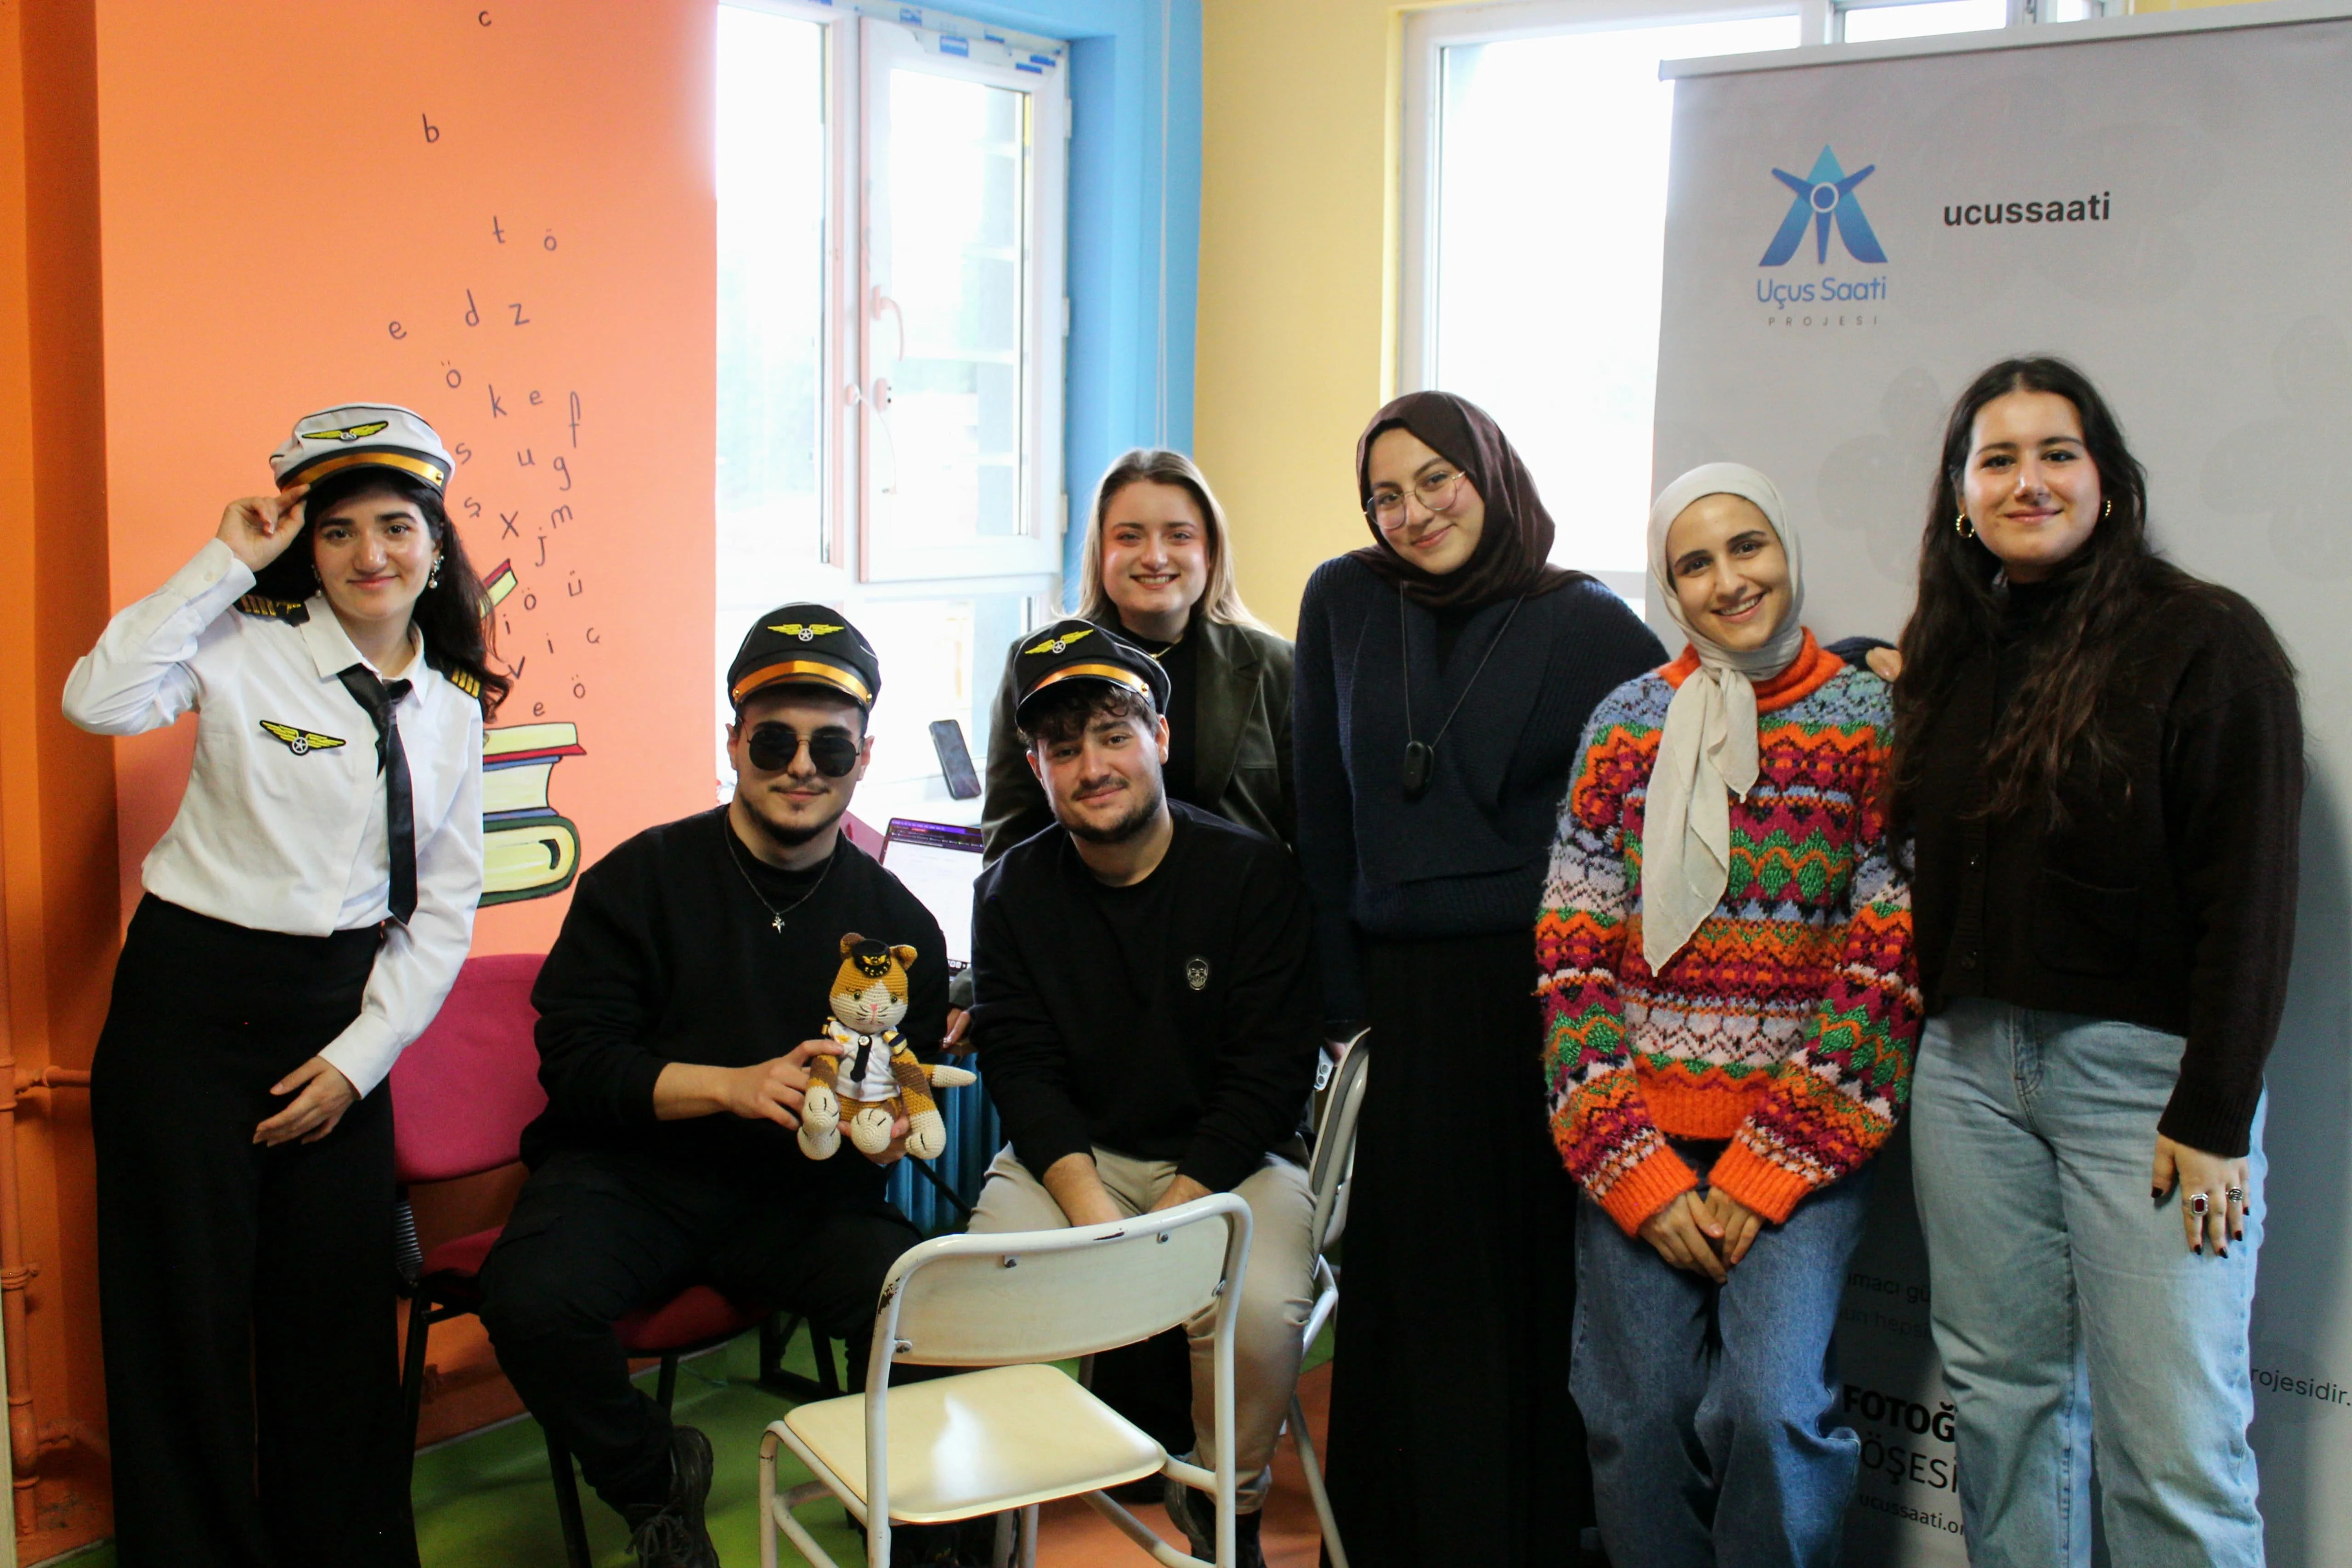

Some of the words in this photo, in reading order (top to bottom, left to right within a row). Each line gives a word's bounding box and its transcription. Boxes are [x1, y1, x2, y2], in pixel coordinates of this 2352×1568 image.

[478, 11, 492, 27] c
[422, 113, 440, 143] b
[1944, 192, 2110, 226] ucussaati
[493, 215, 505, 243] t
[1757, 278, 1815, 310] Uçus
[1820, 276, 1887, 301] Saati
[465, 289, 480, 327] d
[389, 321, 407, 340] e
[441, 361, 462, 389] ö
[488, 384, 507, 418] k
[530, 391, 543, 405] e
[569, 391, 581, 448] f
[455, 443, 472, 464] s
[517, 449, 535, 466] u
[553, 457, 571, 491] g
[551, 505, 573, 529] m
[535, 526, 548, 567] j
[568, 570, 582, 597] ü
[521, 587, 537, 611] ö
[503, 614, 511, 635] i
[546, 632, 554, 654] i
[571, 674, 586, 699] ö
[533, 702, 545, 717] e
